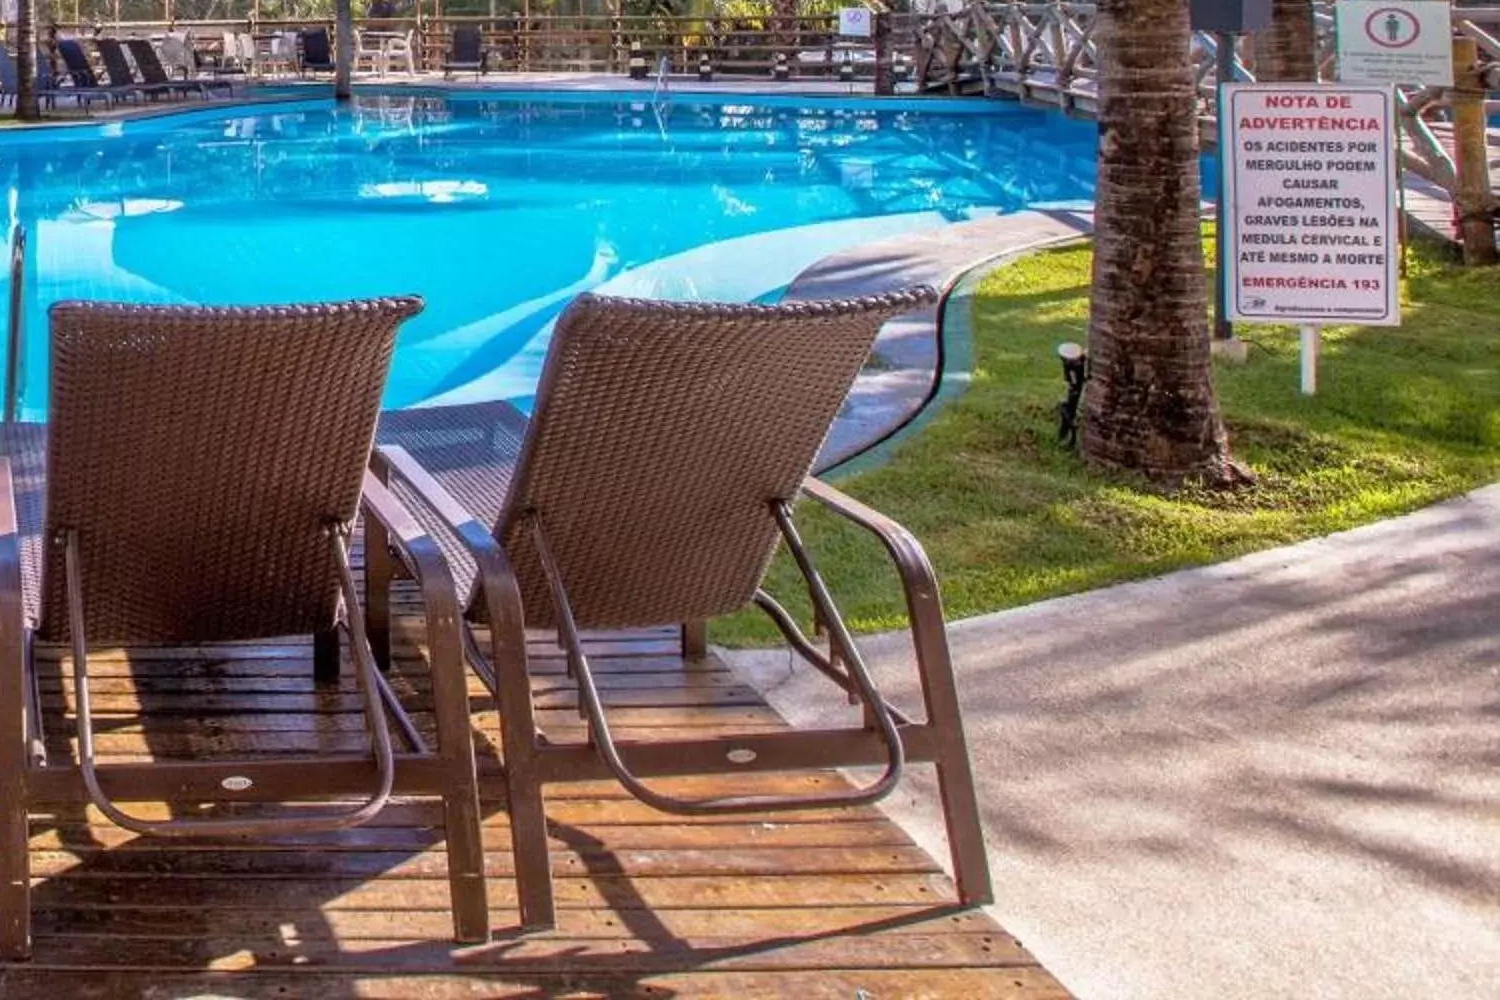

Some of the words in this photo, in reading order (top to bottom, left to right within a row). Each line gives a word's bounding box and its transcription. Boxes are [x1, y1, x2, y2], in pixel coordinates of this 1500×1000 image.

[1265, 96, 1319, 108] NOTA
[1325, 96, 1352, 108] DE
[1239, 115, 1380, 131] ADVERTÊNCIA
[1243, 141, 1263, 152] OS
[1266, 141, 1344, 153] ACIDENTES
[1347, 142, 1377, 153] POR
[1245, 160, 1323, 171] MERGULHO
[1326, 161, 1376, 171] PODEM
[1283, 179, 1339, 189] CAUSAR
[1257, 197, 1365, 210] AFOGAMENTOS,
[1244, 215, 1299, 227] GRAVES
[1301, 214, 1355, 228] LESÕES
[1360, 217, 1379, 228] NA
[1241, 234, 1297, 245] MEDULA
[1301, 234, 1369, 246] CERVICAL
[1373, 236, 1382, 247] E
[1240, 250, 1265, 262] ATÉ
[1269, 252, 1319, 263] MESMO
[1323, 254, 1331, 264] A
[1336, 254, 1384, 265] MORTE
[1243, 276, 1347, 289] EMERGÊNCIA
[1353, 279, 1380, 290] 193
